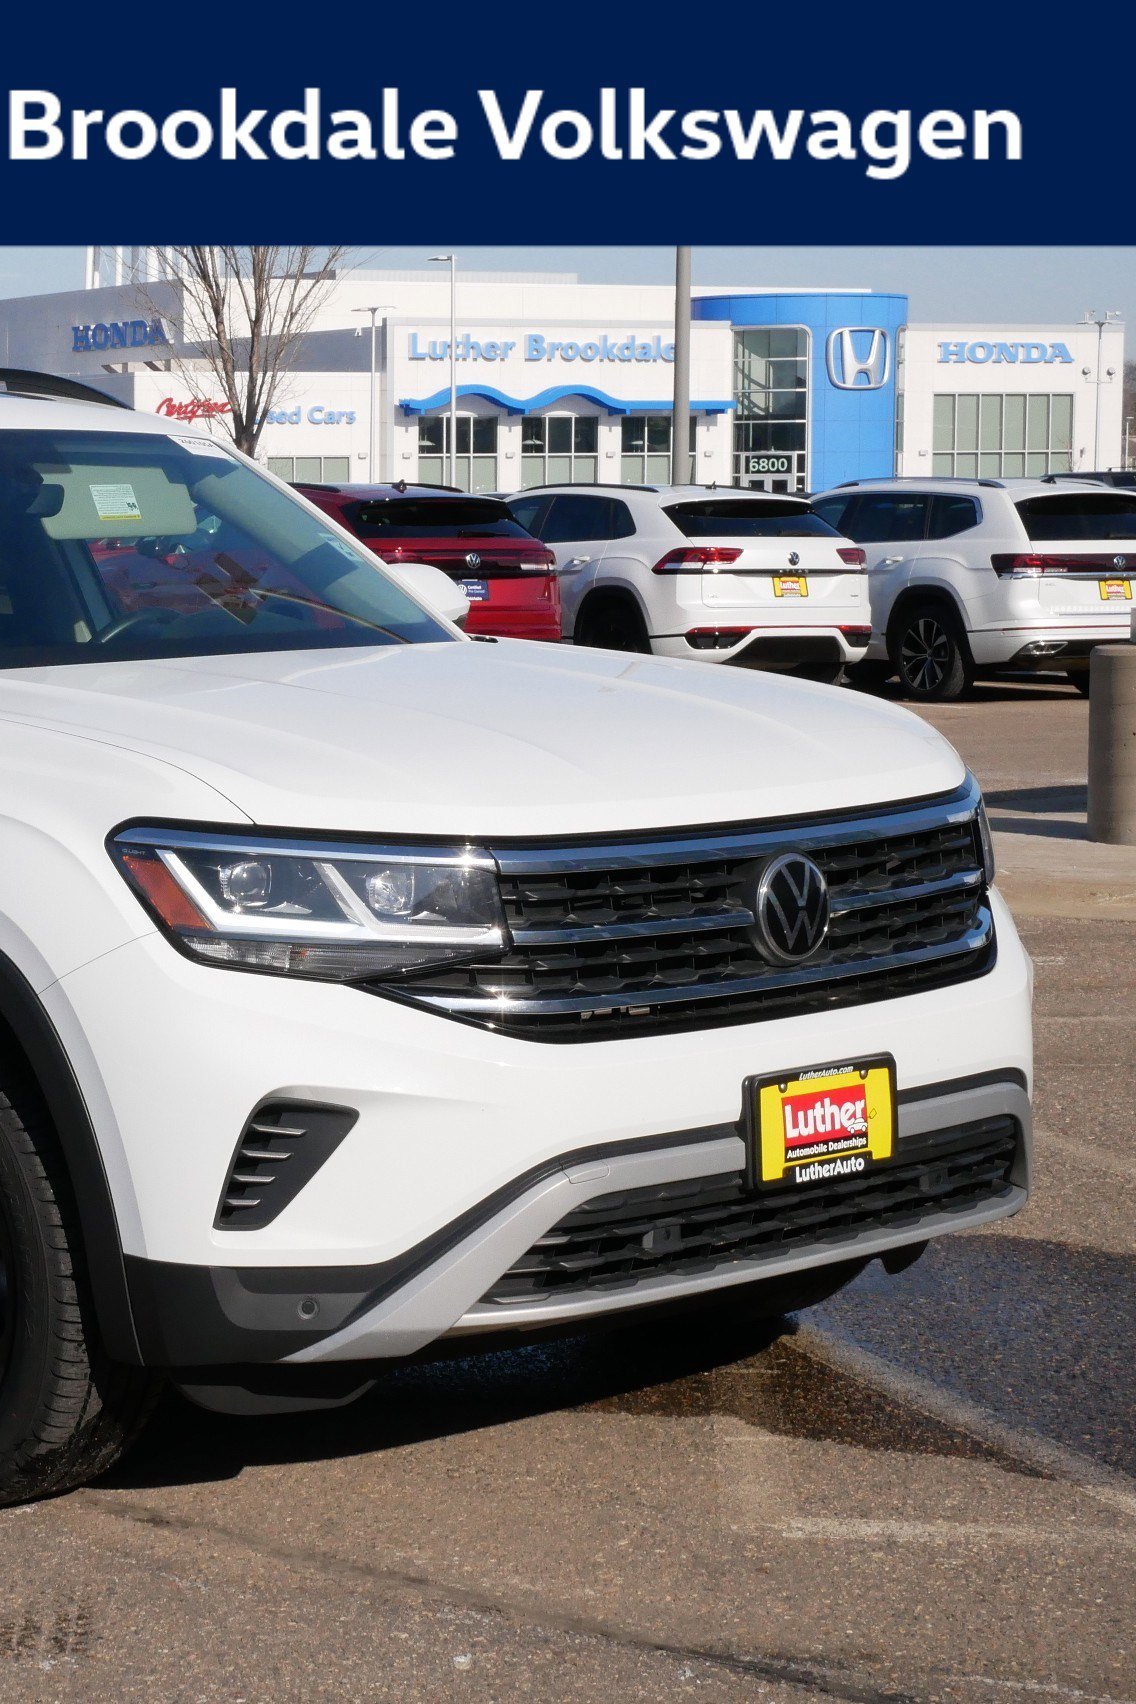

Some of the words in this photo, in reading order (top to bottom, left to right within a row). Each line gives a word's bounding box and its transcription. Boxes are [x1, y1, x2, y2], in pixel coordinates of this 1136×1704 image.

[71, 317, 174, 352] HONDA
[407, 332, 517, 362] Luther
[523, 333, 675, 363] Brookdale
[937, 341, 1075, 364] HONDA
[254, 405, 301, 425] sed
[306, 405, 357, 425] Cars
[748, 457, 788, 472] 6800
[798, 1065, 854, 1081] LutherAuto.com
[784, 1097, 866, 1139] Luther
[786, 1143, 828, 1159] Automobile
[828, 1136, 867, 1152] Dealerships
[795, 1156, 865, 1183] LutherAuto
